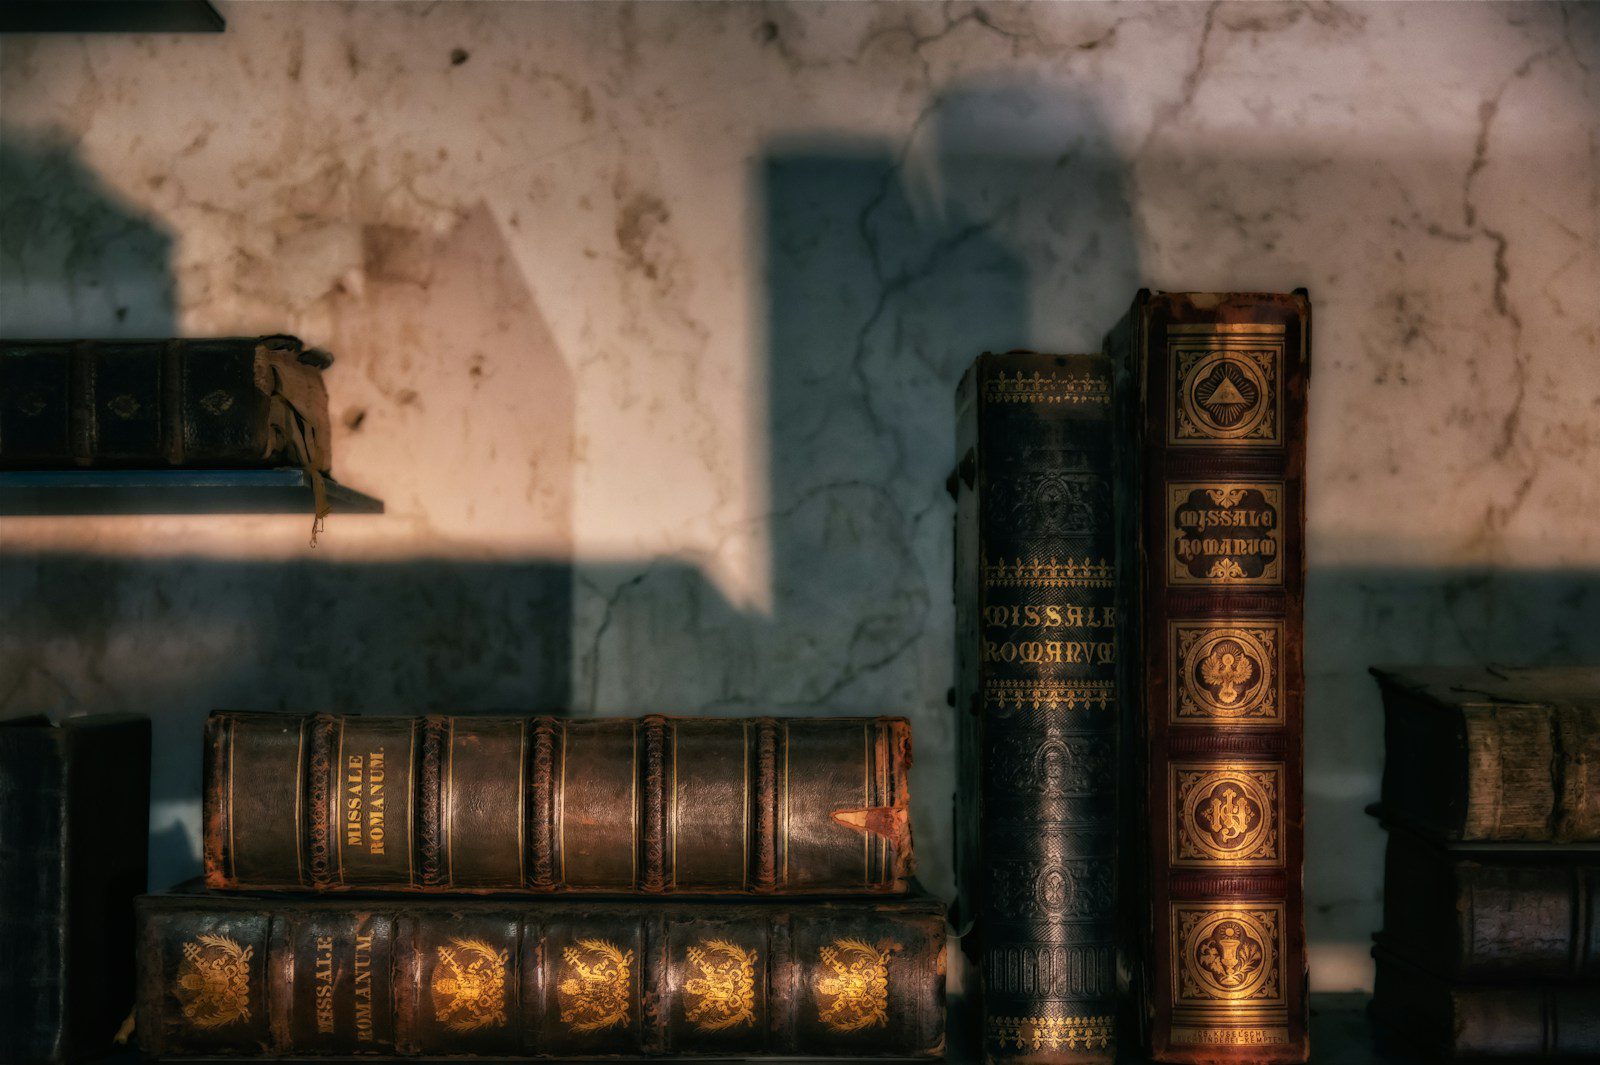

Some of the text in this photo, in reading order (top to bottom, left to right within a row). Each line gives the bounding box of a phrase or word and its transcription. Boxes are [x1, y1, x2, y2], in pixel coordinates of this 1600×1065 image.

[985, 604, 1115, 628] MISSALE
[348, 755, 363, 846] MISSALE
[316, 935, 336, 1033] MISSALE
